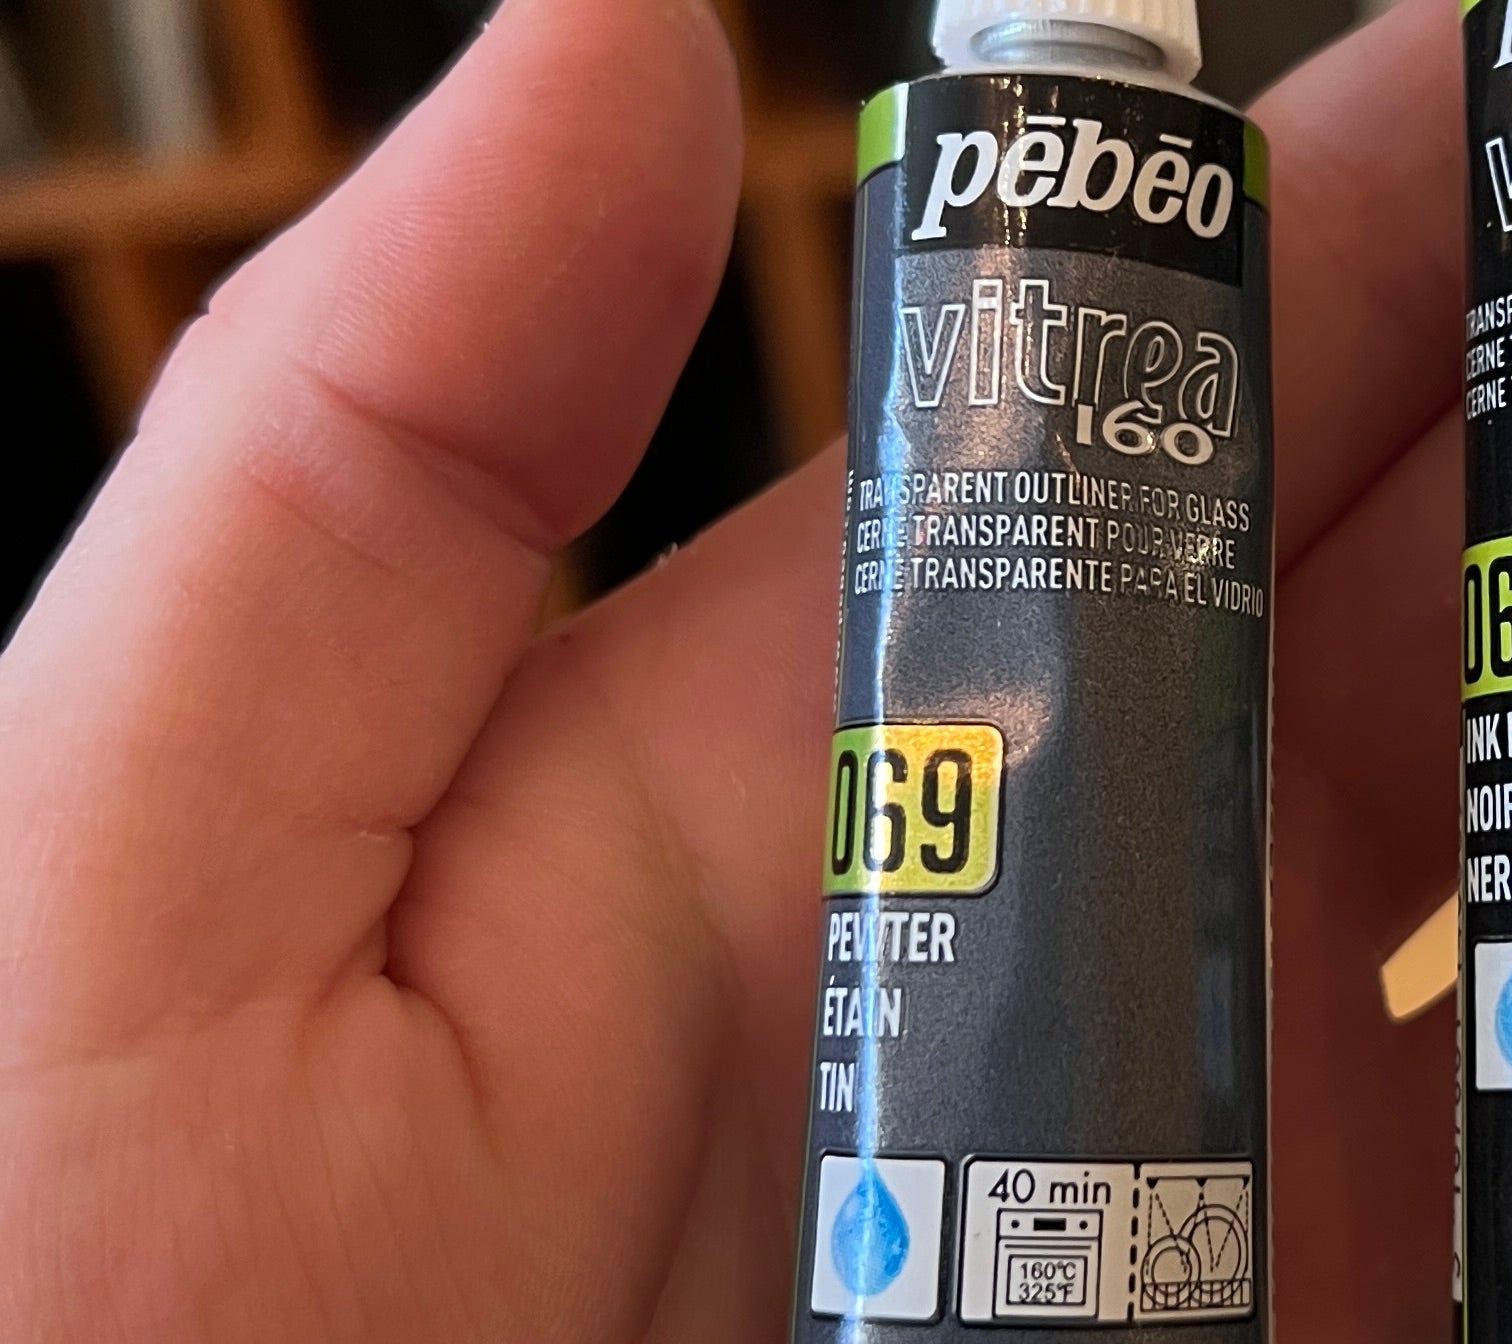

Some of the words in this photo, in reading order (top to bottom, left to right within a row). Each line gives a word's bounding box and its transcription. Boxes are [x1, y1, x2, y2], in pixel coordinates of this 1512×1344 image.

[901, 279, 1240, 438] vitrea
[1466, 336, 1505, 381] CERNE
[1466, 377, 1507, 419] CERNE
[1077, 400, 1214, 465] 160
[1014, 472, 1133, 510] OUTLINER
[1140, 485, 1181, 520] FOR
[1186, 493, 1249, 532] GLASS
[912, 515, 1098, 549] TRANSPARENT
[1107, 520, 1164, 559] POUR
[1170, 529, 1235, 569] VERRE
[911, 557, 1111, 592] TRANSPARENTE
[1121, 563, 1178, 601] PARA
[1184, 572, 1206, 605] EL
[1212, 577, 1263, 618] VIDRIO
[1467, 713, 1501, 764] INK
[832, 748, 972, 876] 069
[828, 912, 955, 962] PEWTER
[988, 1168, 1035, 1203] 40
[1049, 1170, 1111, 1204] min
[1020, 1262, 1076, 1281] 160°C
